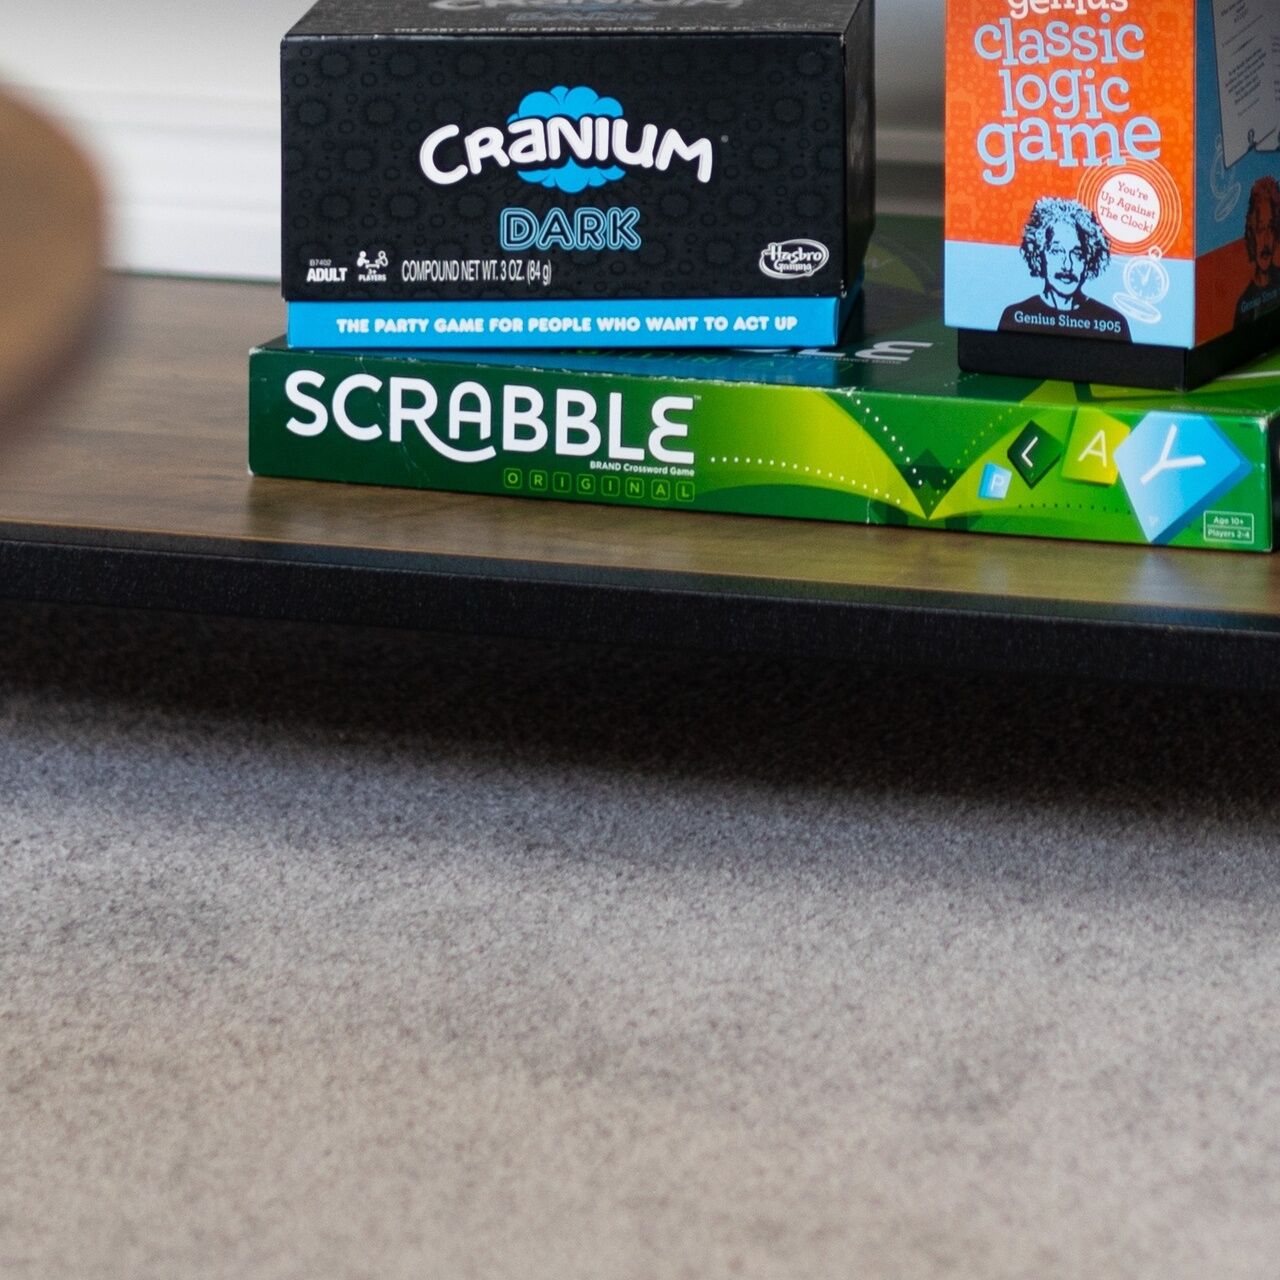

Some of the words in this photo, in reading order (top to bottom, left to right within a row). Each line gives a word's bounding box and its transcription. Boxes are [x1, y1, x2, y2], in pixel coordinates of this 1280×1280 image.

[974, 13, 1145, 66] classic
[999, 69, 1130, 119] logic
[976, 115, 1161, 186] game
[1118, 181, 1149, 200] You're
[1101, 191, 1115, 205] Up
[1117, 197, 1155, 219] Against
[500, 207, 641, 250] DARK
[1100, 205, 1118, 220] The
[1121, 214, 1154, 233] Clock!
[765, 245, 822, 263] Hasbro
[306, 267, 348, 282] ADULT
[402, 260, 459, 282] COMPOUND
[461, 260, 480, 281] NET
[482, 260, 498, 281] WT.
[500, 260, 507, 281] 3
[509, 260, 524, 281] OZ.
[527, 259, 541, 285] (84
[543, 260, 552, 286] g)
[773, 260, 812, 273] Gaming
[336, 318, 369, 333] THE
[375, 318, 429, 333] PARTY
[434, 318, 484, 333] GAME
[489, 318, 523, 333] FOR
[528, 317, 591, 333] PEOPLE
[597, 317, 640, 332] WHO
[646, 317, 698, 332] WANT
[703, 317, 729, 331] TO
[734, 317, 769, 331] ACT
[775, 317, 798, 331] UP
[1014, 311, 1056, 326] Genius
[1058, 314, 1090, 329] Since
[1094, 319, 1121, 333] 1905
[284, 370, 696, 464] SCRABBLE
[590, 460, 621, 471] BRAND
[623, 463, 668, 476] Crossword
[670, 467, 695, 477] Game
[507, 472, 690, 498] ORIGINAL
[1213, 516, 1229, 525] Age
[1231, 517, 1244, 525] 10+
[1208, 528, 1236, 539] Players
[1237, 530, 1250, 539] 2-4
